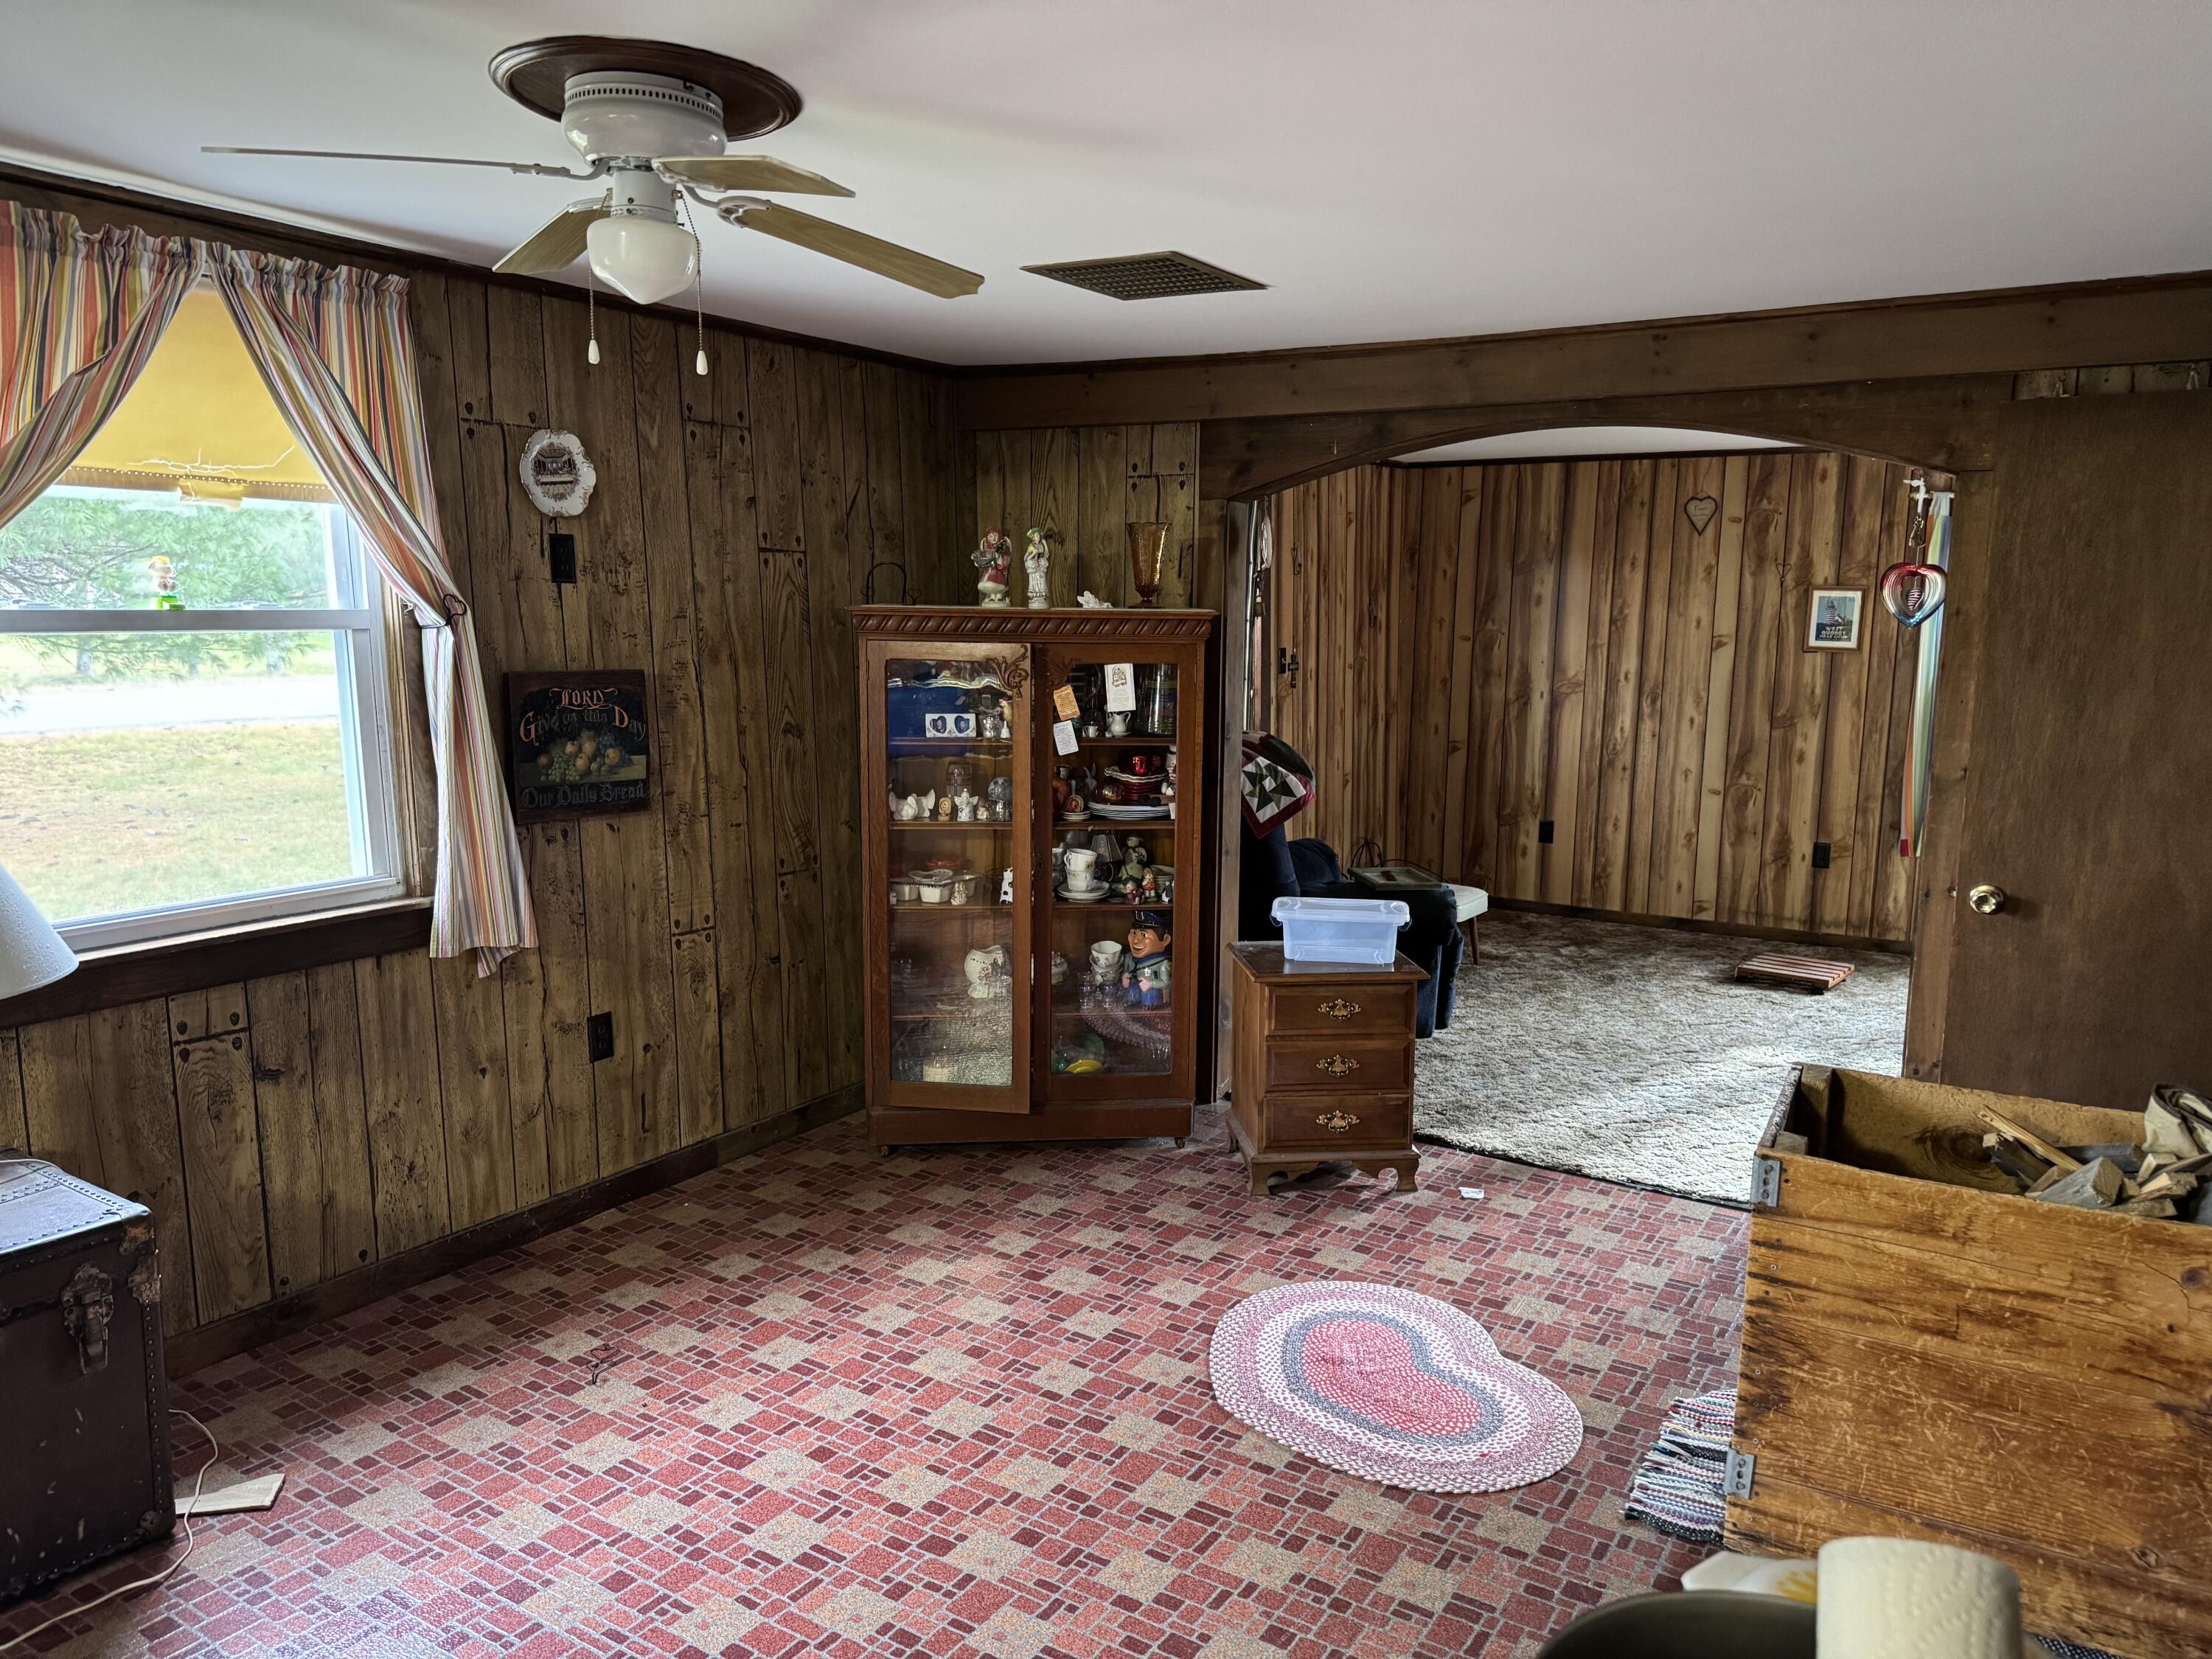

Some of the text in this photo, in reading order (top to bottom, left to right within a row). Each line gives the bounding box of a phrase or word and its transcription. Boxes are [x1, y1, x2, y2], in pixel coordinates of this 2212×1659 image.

[554, 688, 614, 710] LORD
[612, 705, 647, 742] Day
[521, 780, 647, 809] Our Daily Bread
